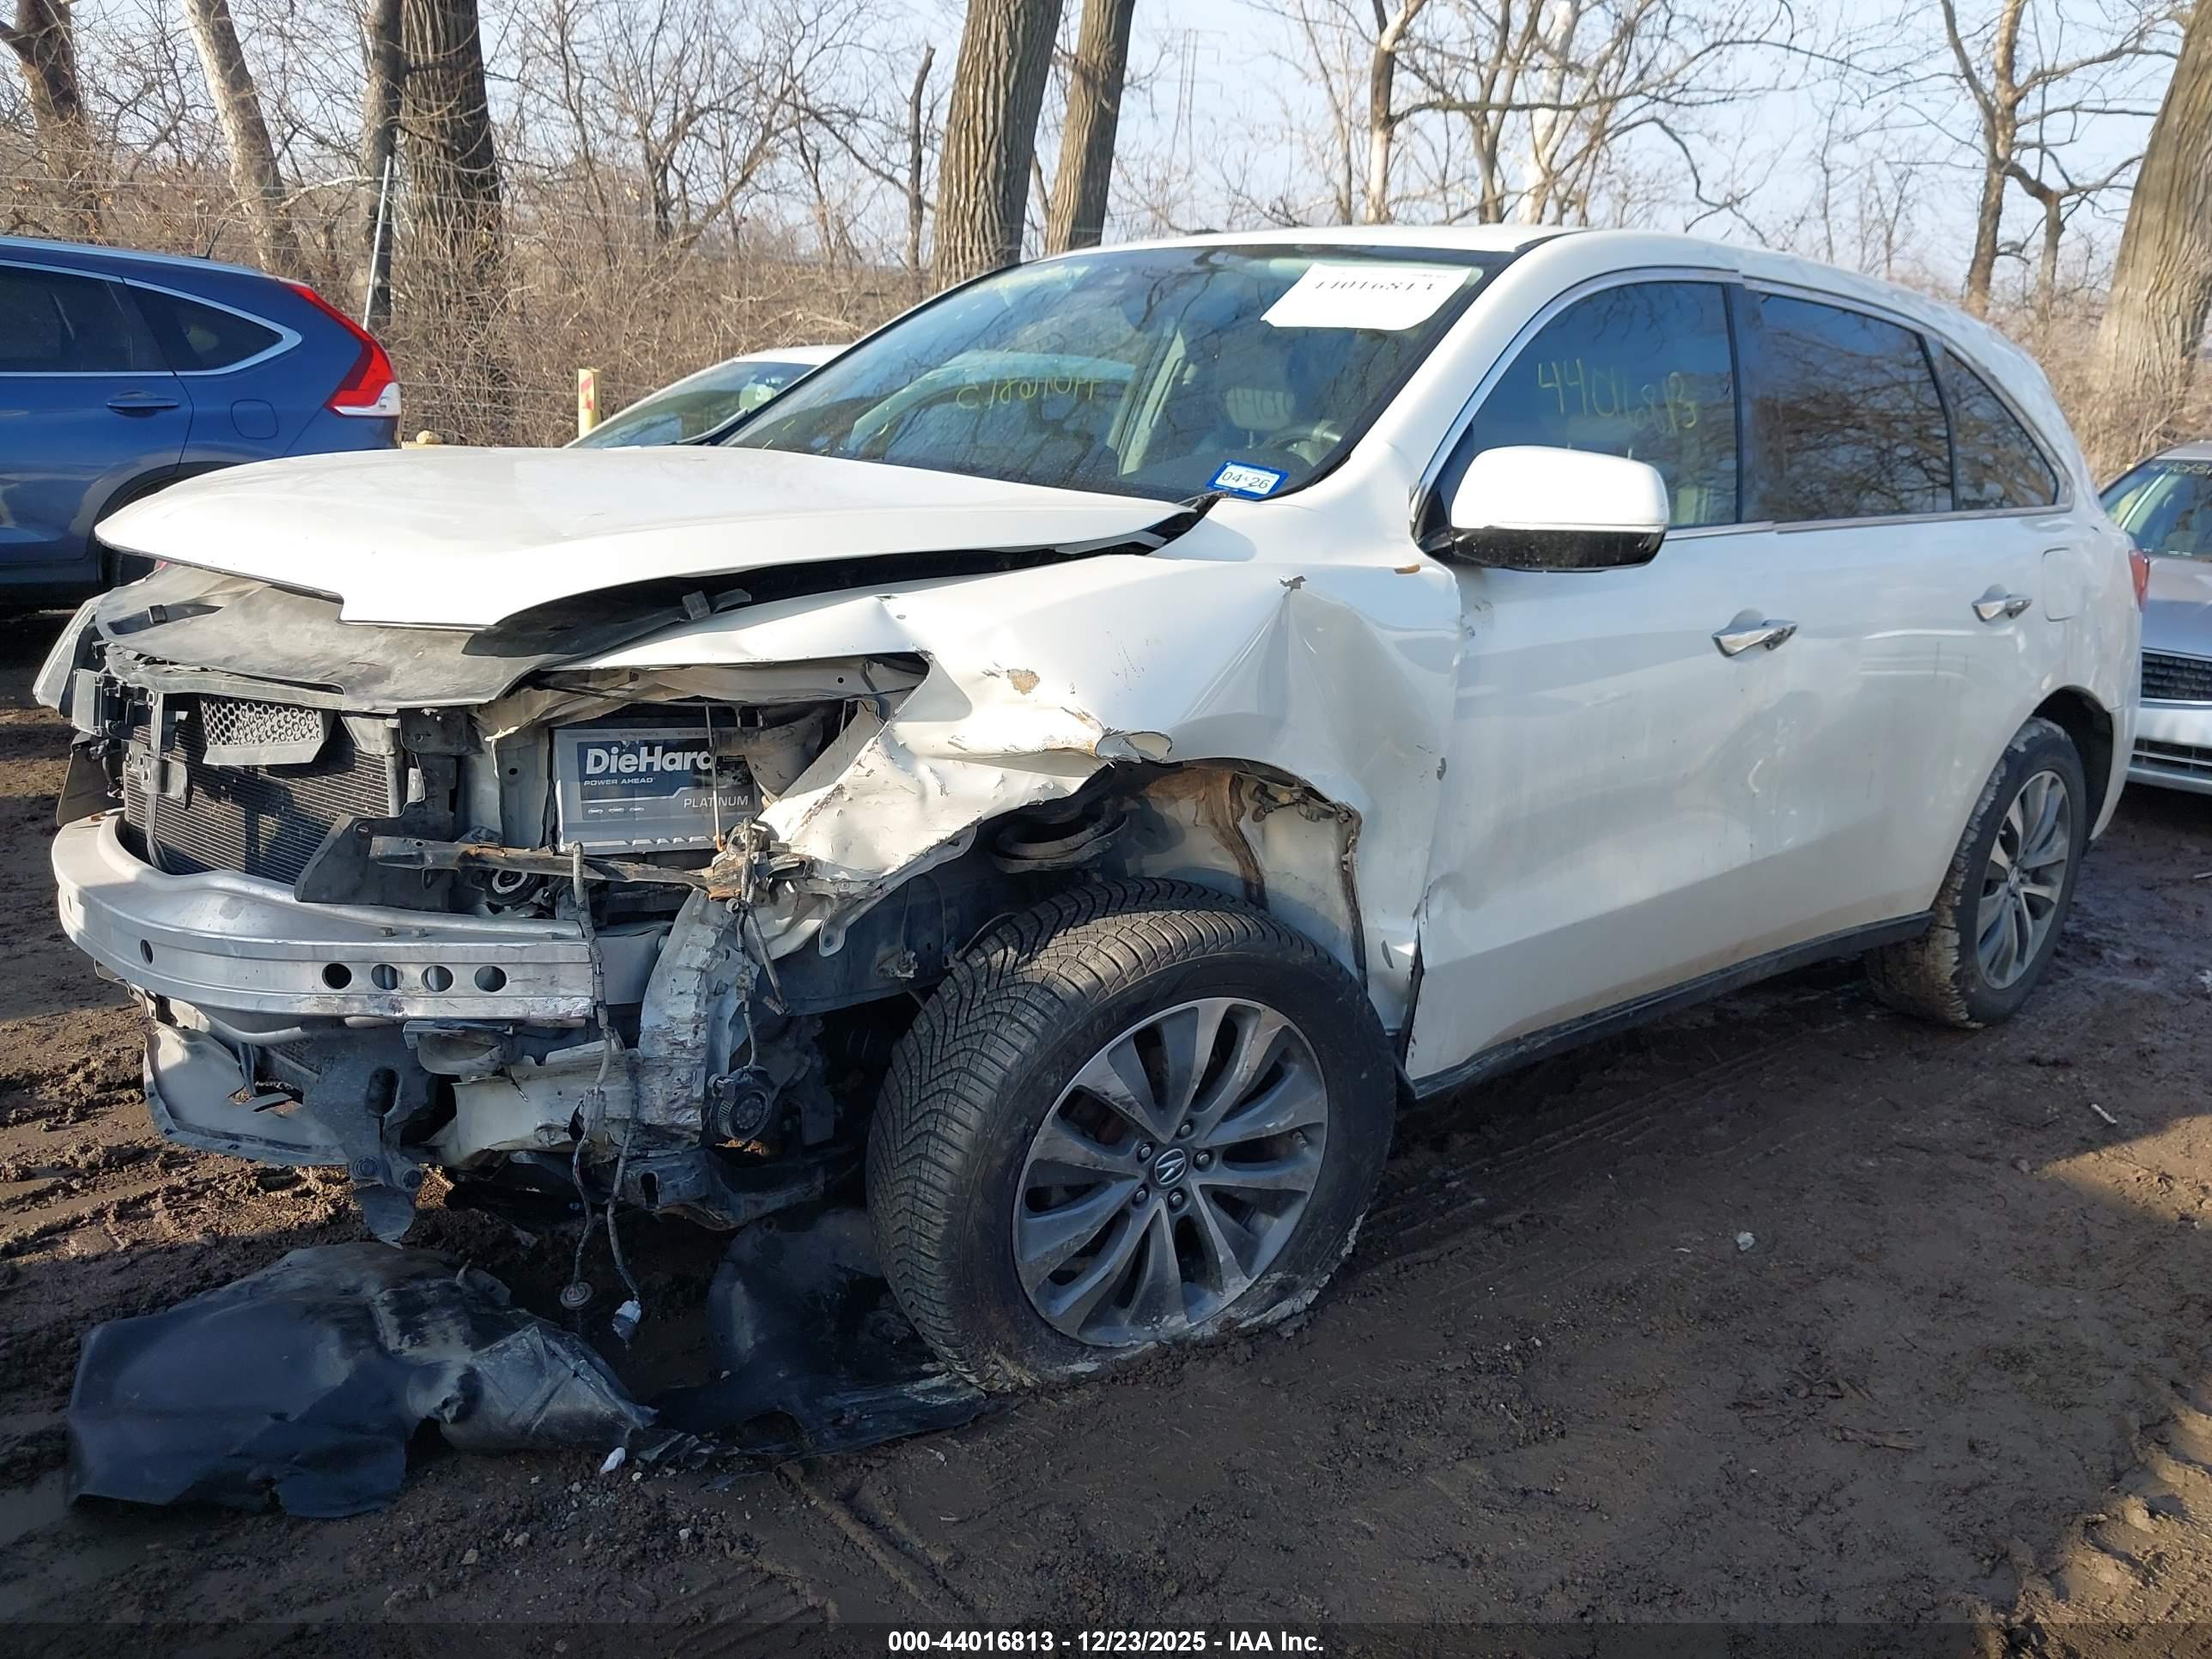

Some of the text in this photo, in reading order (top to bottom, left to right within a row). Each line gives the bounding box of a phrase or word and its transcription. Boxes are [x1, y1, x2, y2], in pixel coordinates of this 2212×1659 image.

[1222, 471, 1243, 483] 04
[1249, 477, 1270, 489] 26
[684, 795, 749, 809] PLATNUM
